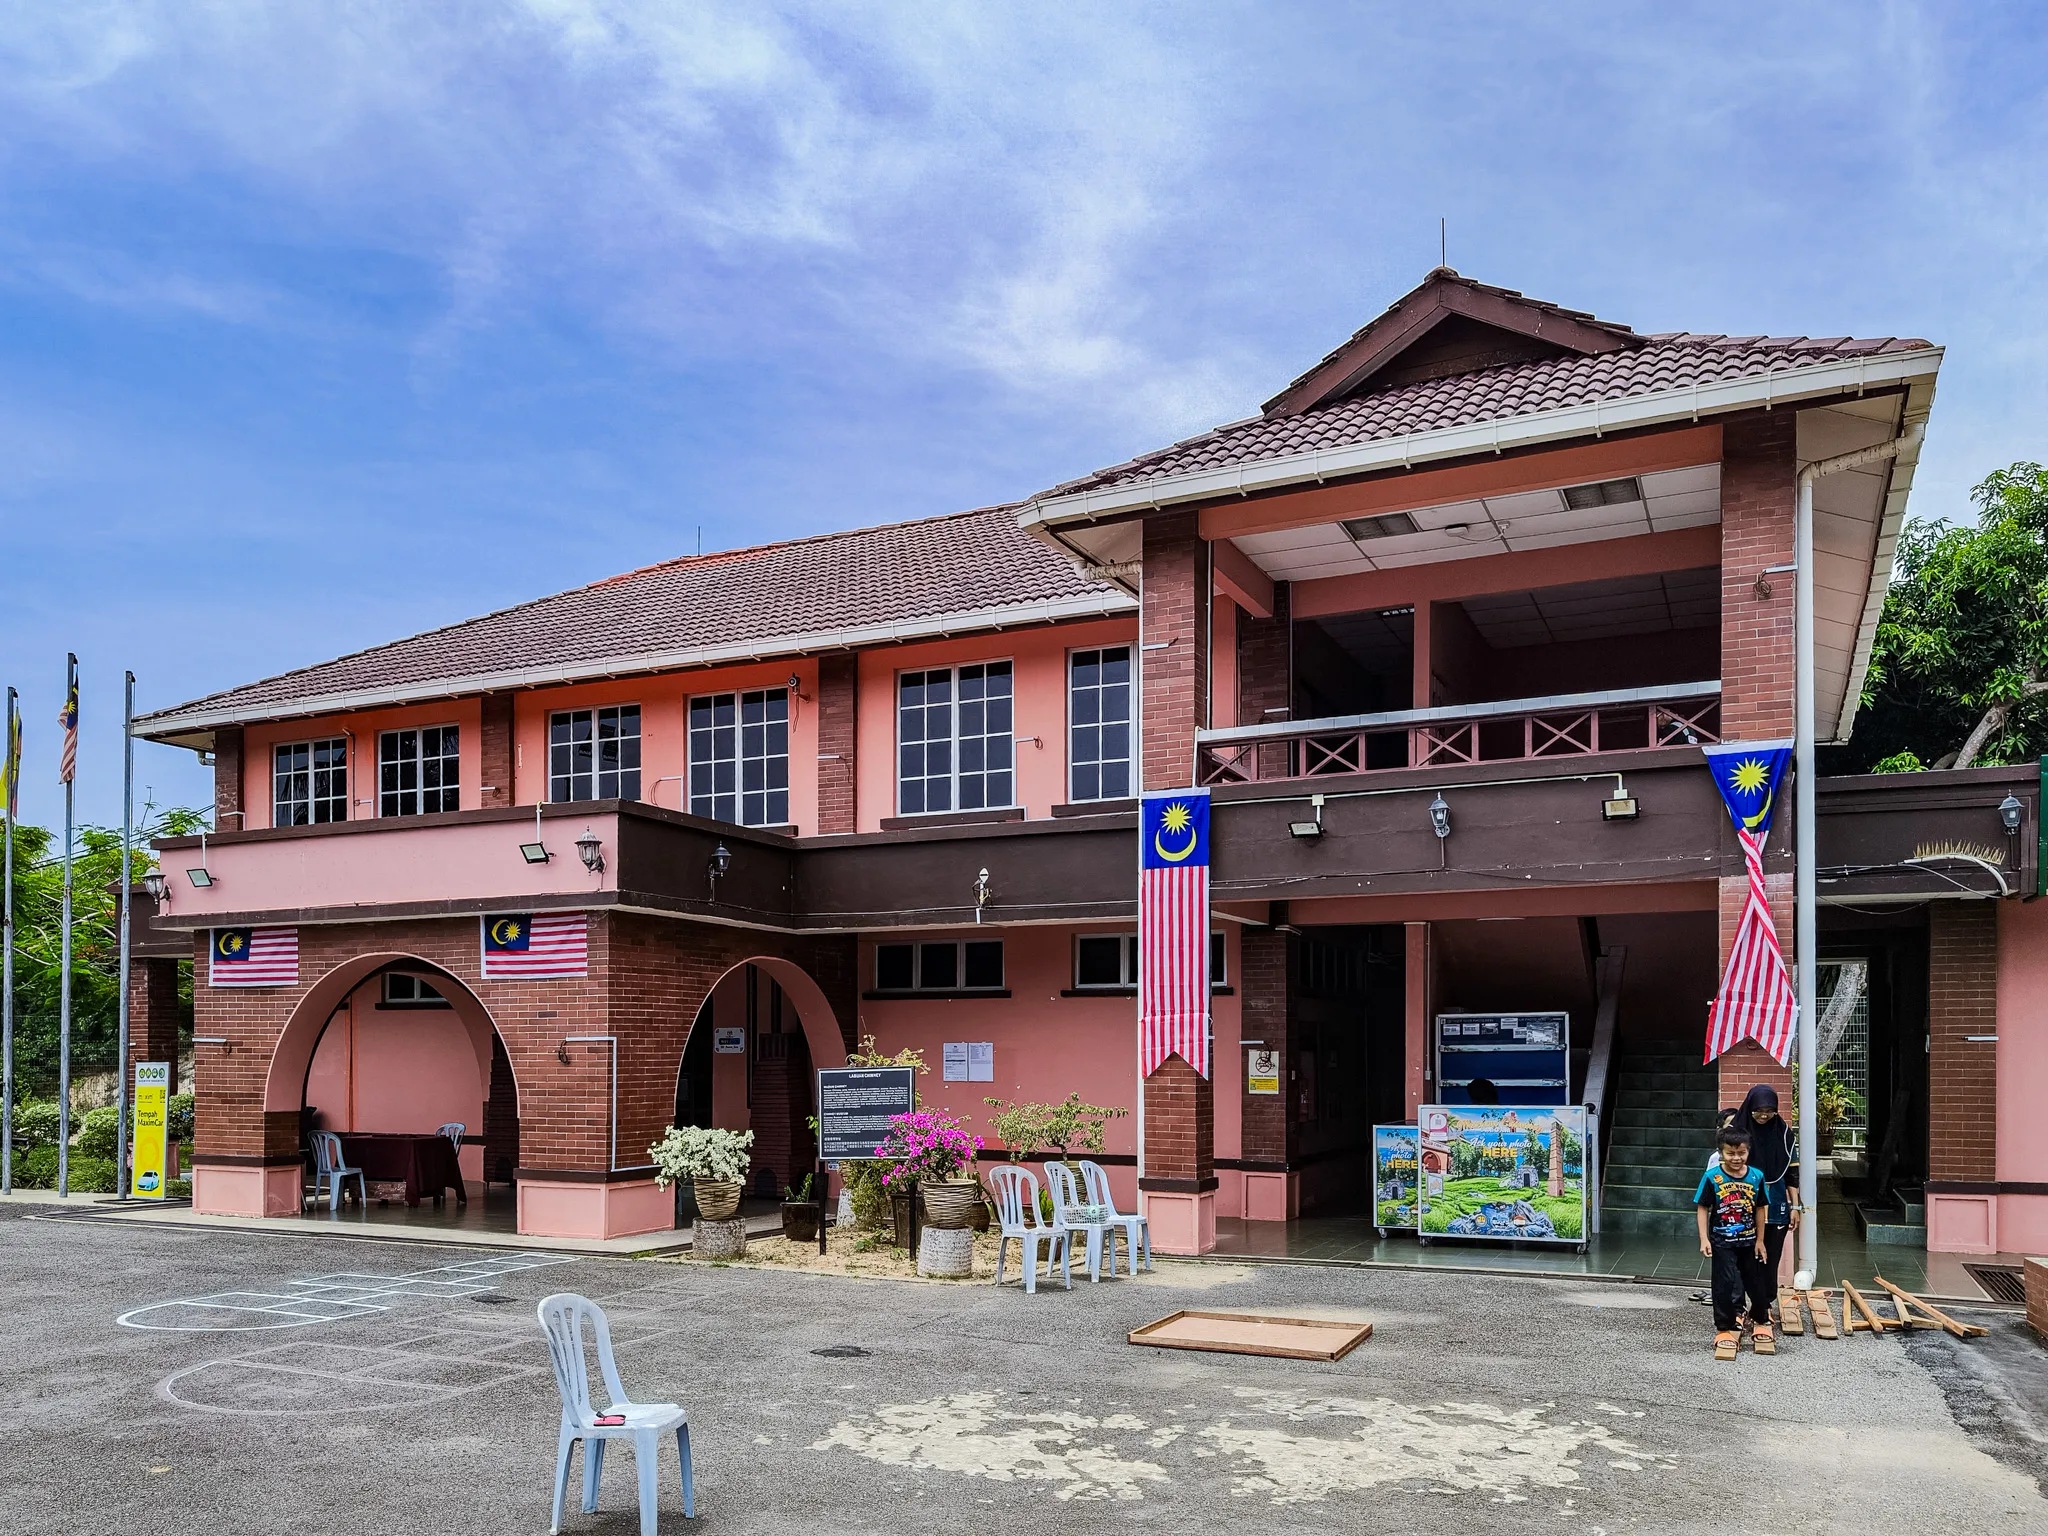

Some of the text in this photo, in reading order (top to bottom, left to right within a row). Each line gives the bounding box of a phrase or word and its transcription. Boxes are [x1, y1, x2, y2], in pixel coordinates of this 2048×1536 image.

[138, 1110, 157, 1120] Tempah
[1487, 1141, 1508, 1150] your
[1508, 1138, 1532, 1150] photo
[1482, 1148, 1518, 1157] HERE
[1386, 1160, 1418, 1169] HERE
